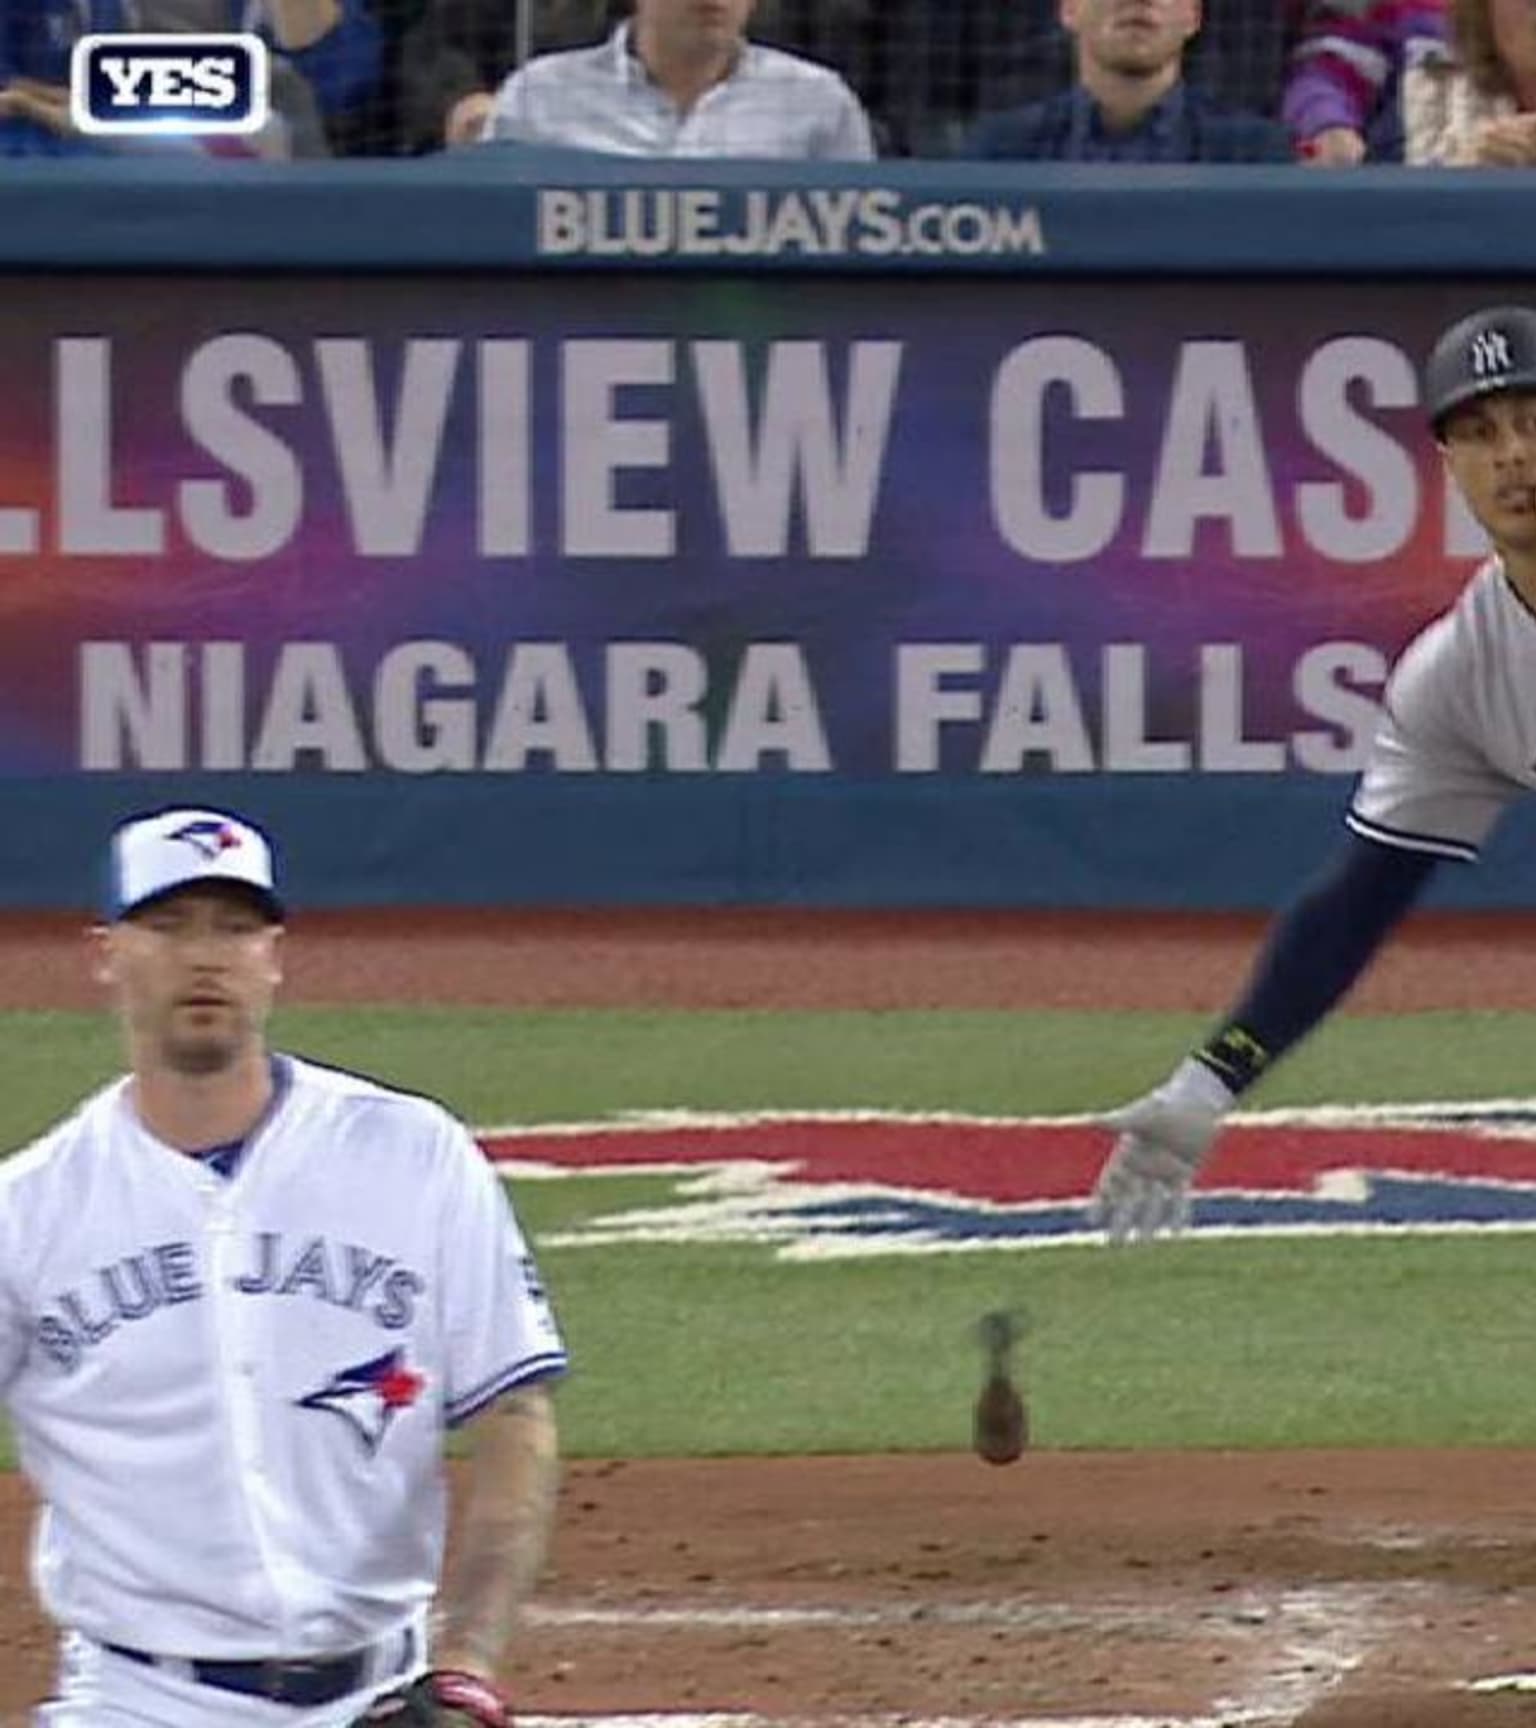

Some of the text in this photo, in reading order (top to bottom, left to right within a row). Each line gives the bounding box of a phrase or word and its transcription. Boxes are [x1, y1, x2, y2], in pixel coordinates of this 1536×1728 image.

[536, 189, 1044, 255] BLUEJAYS.COM
[0, 334, 904, 562] LSVIEW
[80, 640, 1390, 773] NIAGARA FALLS
[37, 1241, 206, 1374] BLUE
[233, 1231, 426, 1330] JAYS
